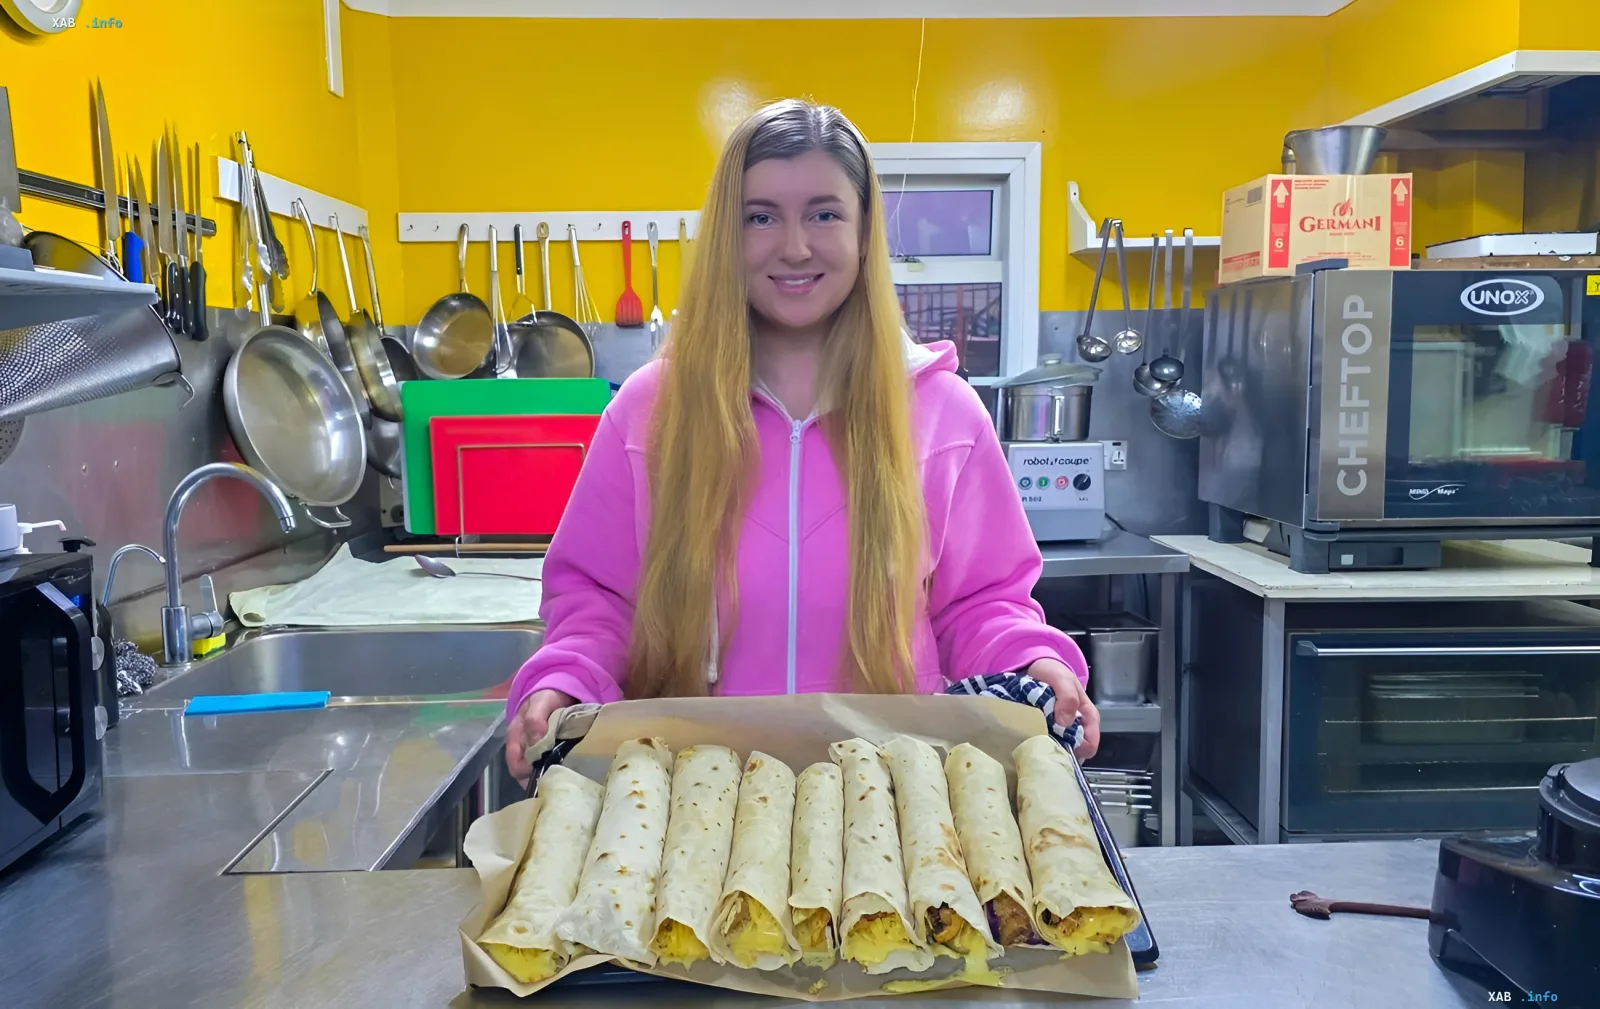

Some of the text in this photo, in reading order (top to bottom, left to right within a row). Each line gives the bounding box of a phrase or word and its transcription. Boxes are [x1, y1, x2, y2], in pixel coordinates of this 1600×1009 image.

[1299, 215, 1382, 233] GERMANI
[1275, 237, 1284, 249] 6
[1395, 235, 1405, 247] 6
[1470, 290, 1530, 305] UNOX
[1336, 294, 1374, 496] CHEFTOP
[1023, 456, 1090, 466] robot coupe
